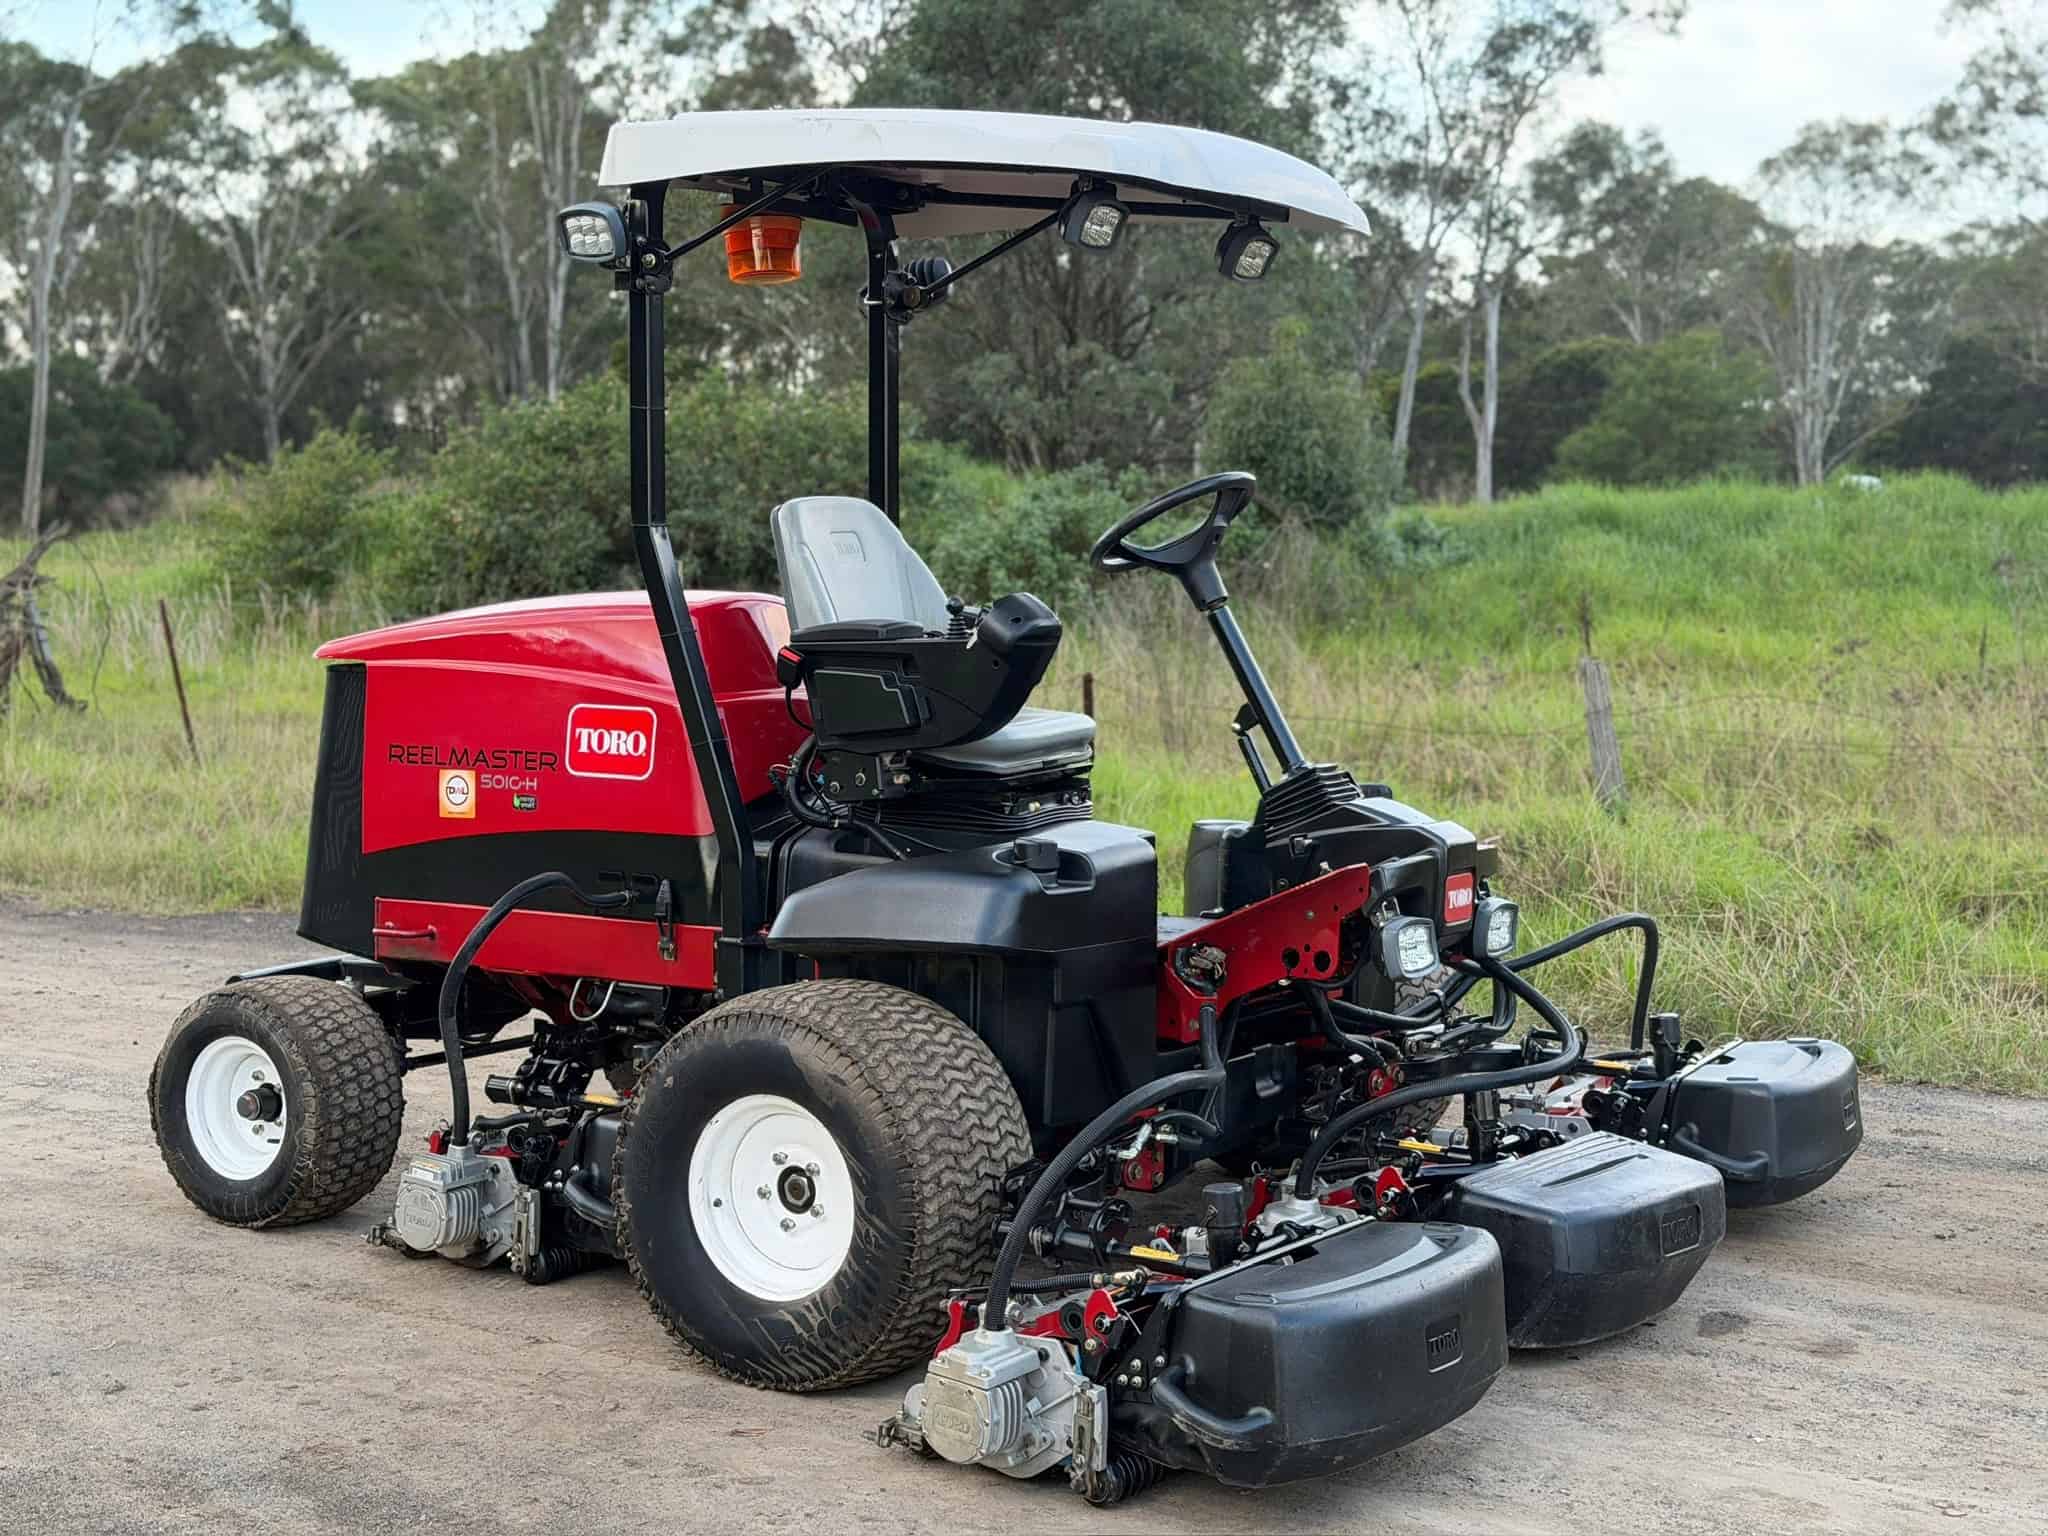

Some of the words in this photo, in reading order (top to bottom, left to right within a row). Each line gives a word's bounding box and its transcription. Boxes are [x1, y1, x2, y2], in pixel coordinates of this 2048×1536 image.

[575, 728, 647, 757] TORO
[388, 744, 558, 771] REELMASTER
[480, 774, 537, 791] 5010-H
[1447, 887, 1473, 910] TORO
